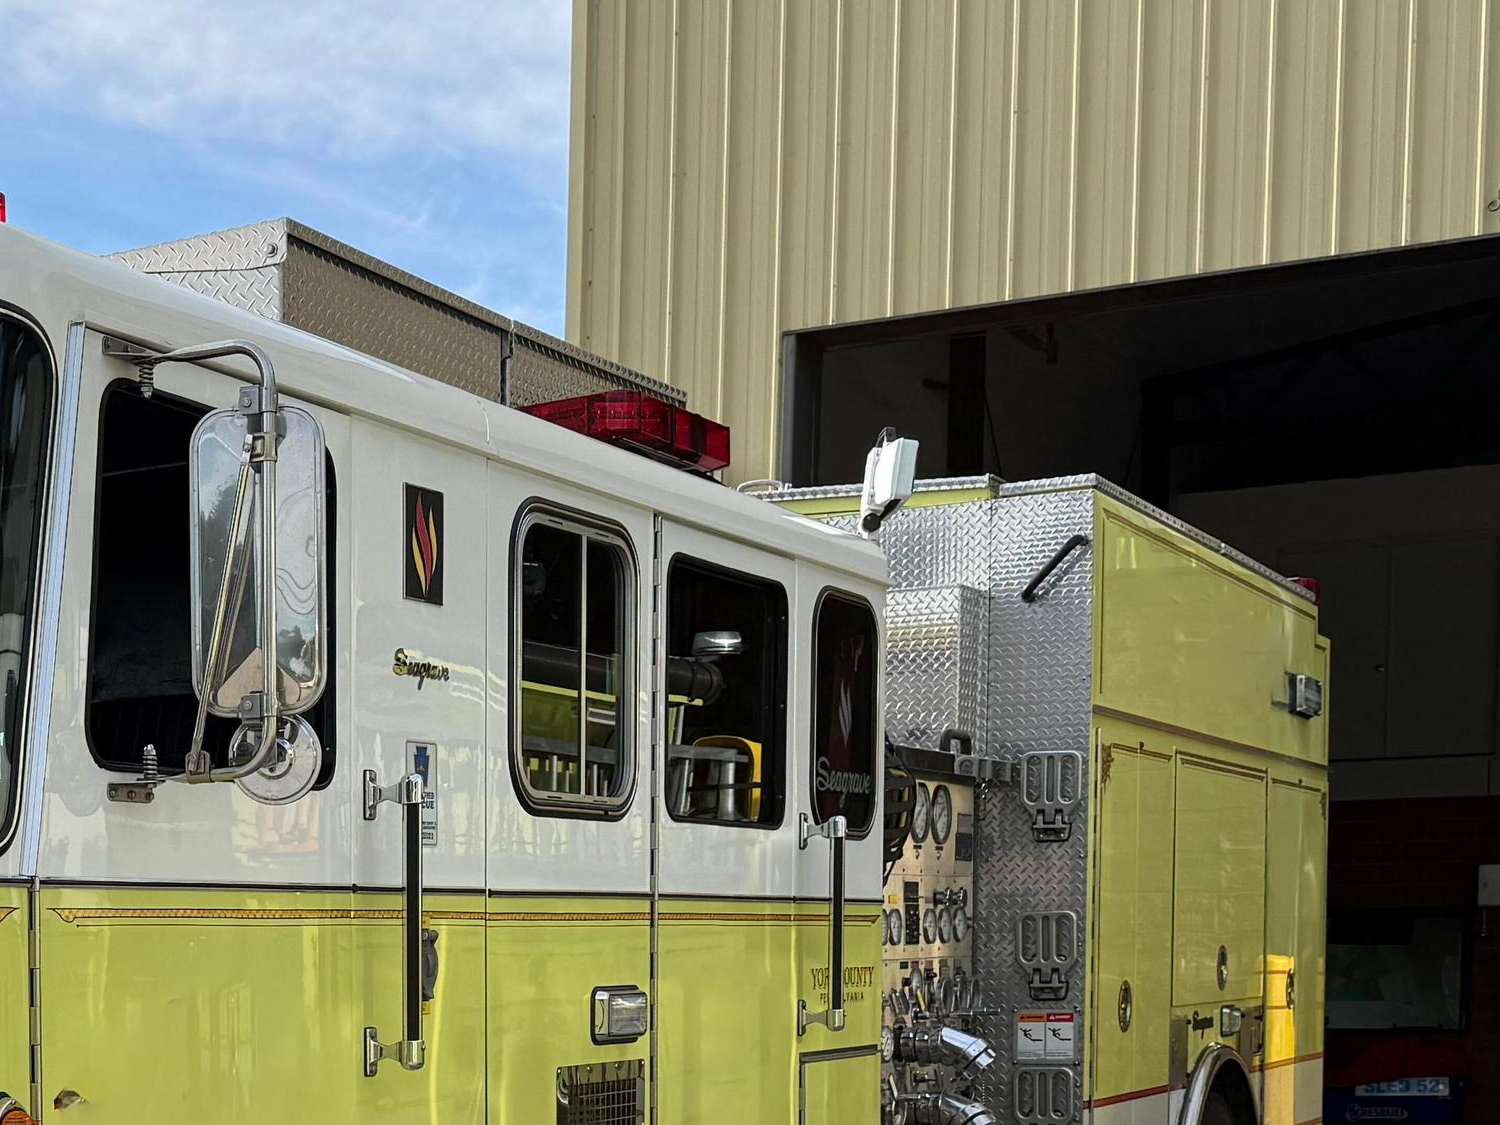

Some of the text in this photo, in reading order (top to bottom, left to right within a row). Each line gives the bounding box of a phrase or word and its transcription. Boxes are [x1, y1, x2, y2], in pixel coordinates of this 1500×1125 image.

[393, 648, 450, 690] Seagrave
[817, 756, 871, 809] Seagrave
[844, 966, 875, 987] OUNTY
